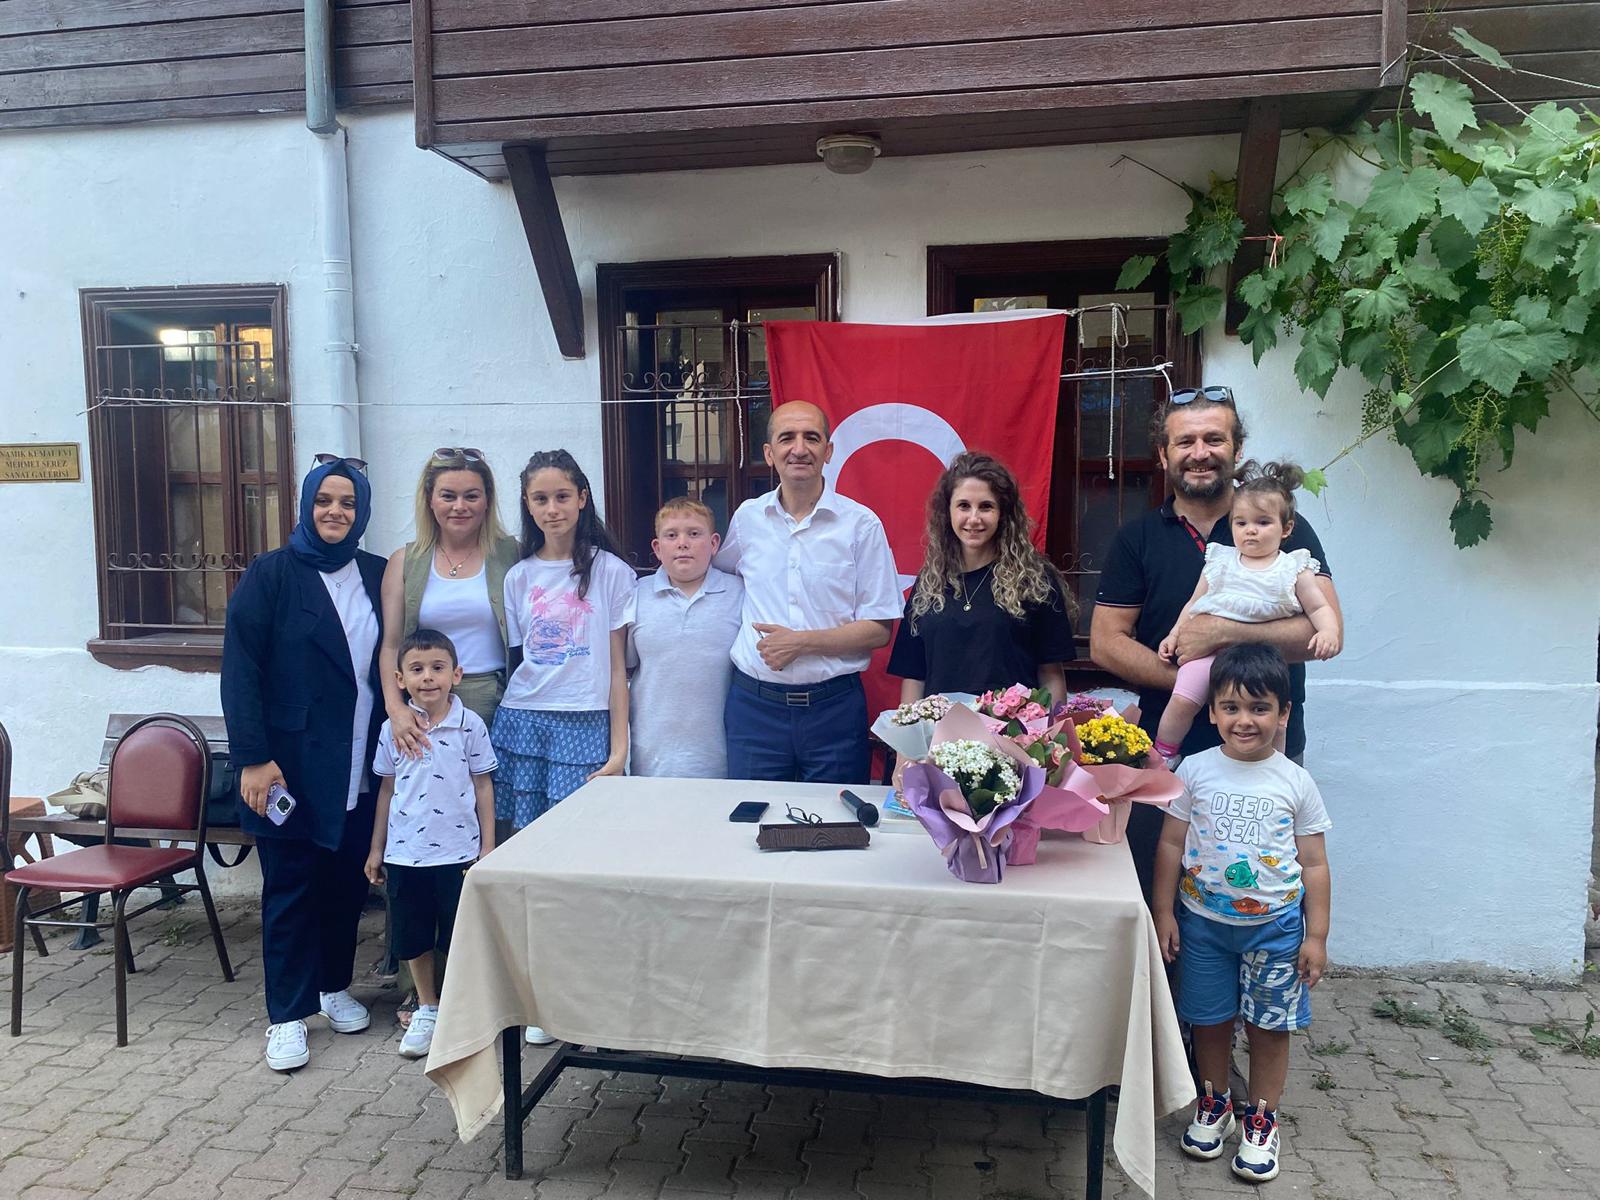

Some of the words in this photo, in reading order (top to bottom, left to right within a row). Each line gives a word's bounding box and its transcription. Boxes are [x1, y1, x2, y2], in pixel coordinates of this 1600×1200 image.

[28, 448, 57, 457] KEMAL
[6, 460, 39, 468] MEHMET
[1211, 792, 1274, 821] DEEP
[1214, 817, 1260, 846] SEA
